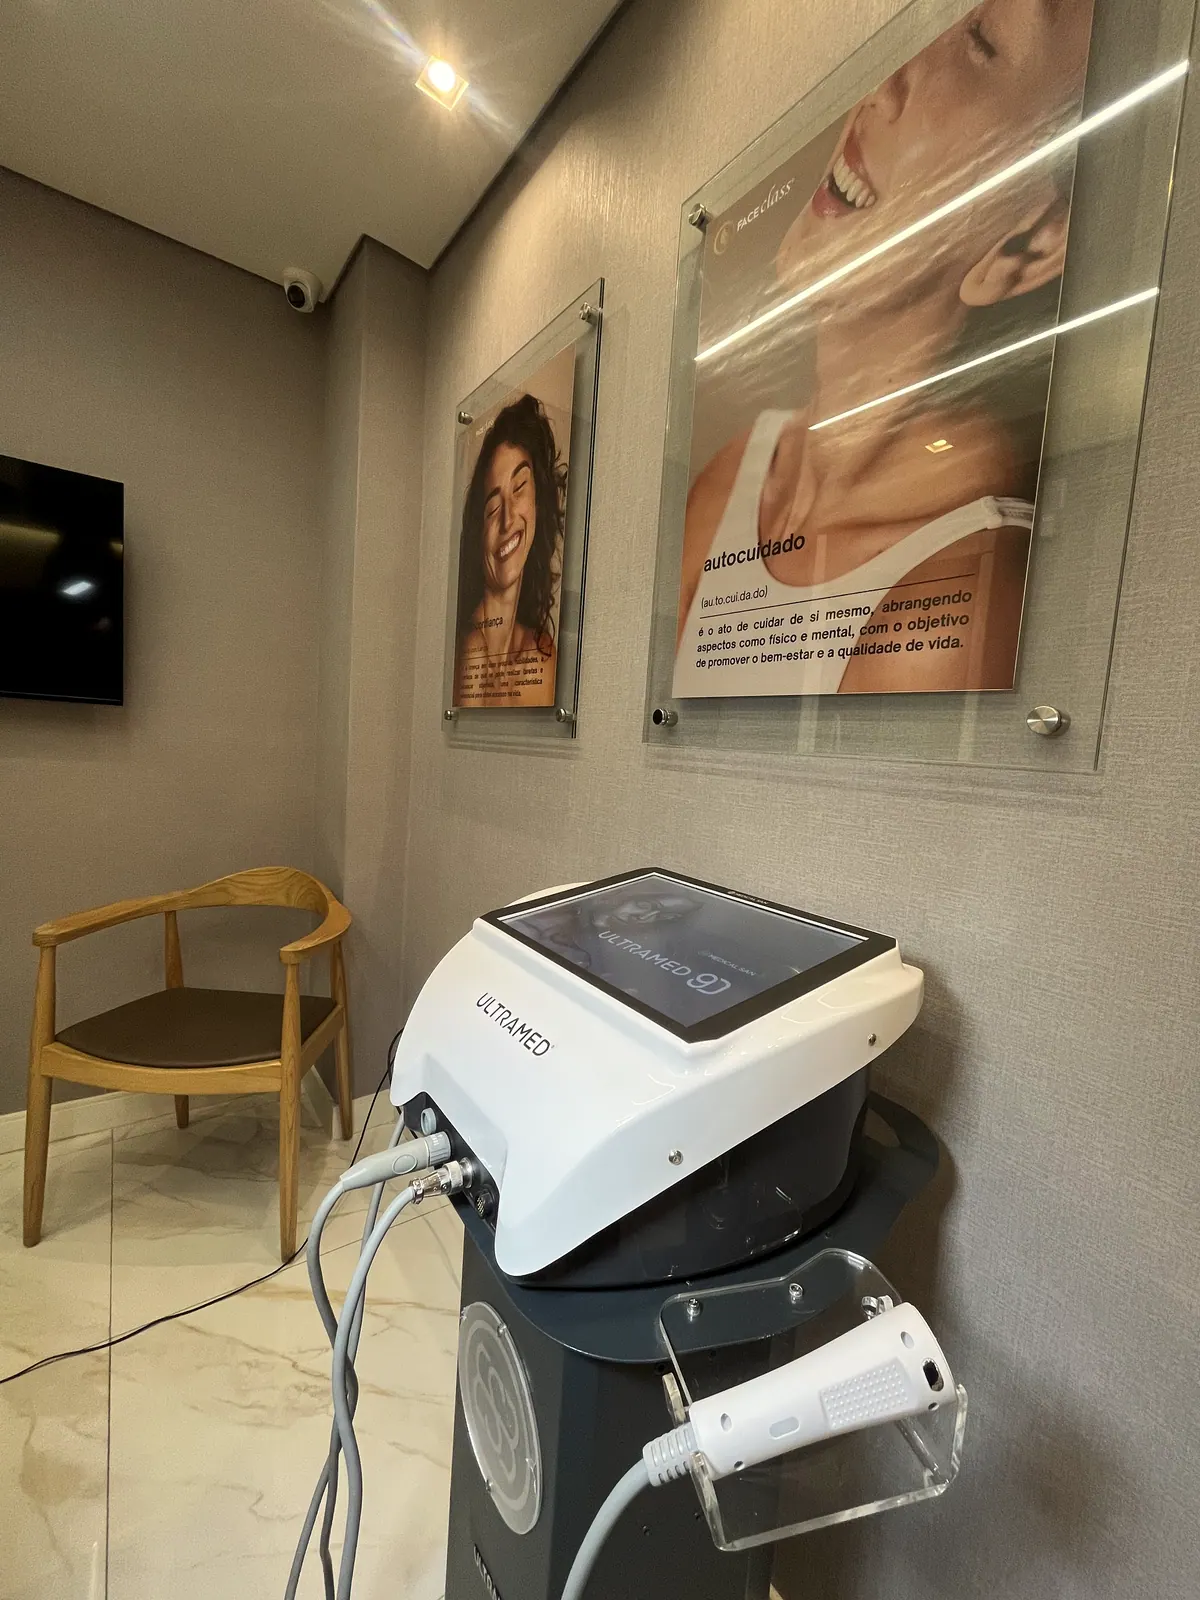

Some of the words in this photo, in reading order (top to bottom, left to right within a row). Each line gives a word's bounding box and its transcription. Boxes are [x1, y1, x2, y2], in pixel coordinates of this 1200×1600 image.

[736, 206, 760, 232] FACE
[704, 533, 805, 572] autocuidado
[698, 627, 704, 637] é
[708, 627, 714, 635] o
[718, 624, 732, 634] ato
[737, 621, 749, 632] de
[753, 617, 785, 630] cuidar
[790, 614, 803, 625] de
[809, 610, 820, 622] si
[825, 605, 874, 621] mesmo,
[882, 590, 972, 613] abrangendo
[701, 585, 768, 609] (au.to.cui.da.do)
[696, 658, 706, 668] de
[708, 655, 750, 669] promover
[752, 655, 758, 663] o
[761, 649, 814, 663] bem-estar
[817, 649, 825, 658] e
[827, 648, 834, 658] a
[837, 641, 901, 659] qualidade
[906, 639, 924, 651] de
[928, 636, 964, 650] vida.
[697, 640, 736, 653] aspectos
[739, 637, 766, 648] como
[769, 633, 797, 645] físico
[800, 632, 808, 641] e
[811, 625, 855, 641] mental,
[860, 623, 888, 635] com
[893, 622, 902, 632] o
[907, 613, 970, 632] objetivo
[598, 930, 692, 976] ULTRAMED
[708, 954, 738, 969] MEDICAL
[476, 992, 551, 1057] ULTRAMED
[473, 1545, 501, 1600] ULTRA
